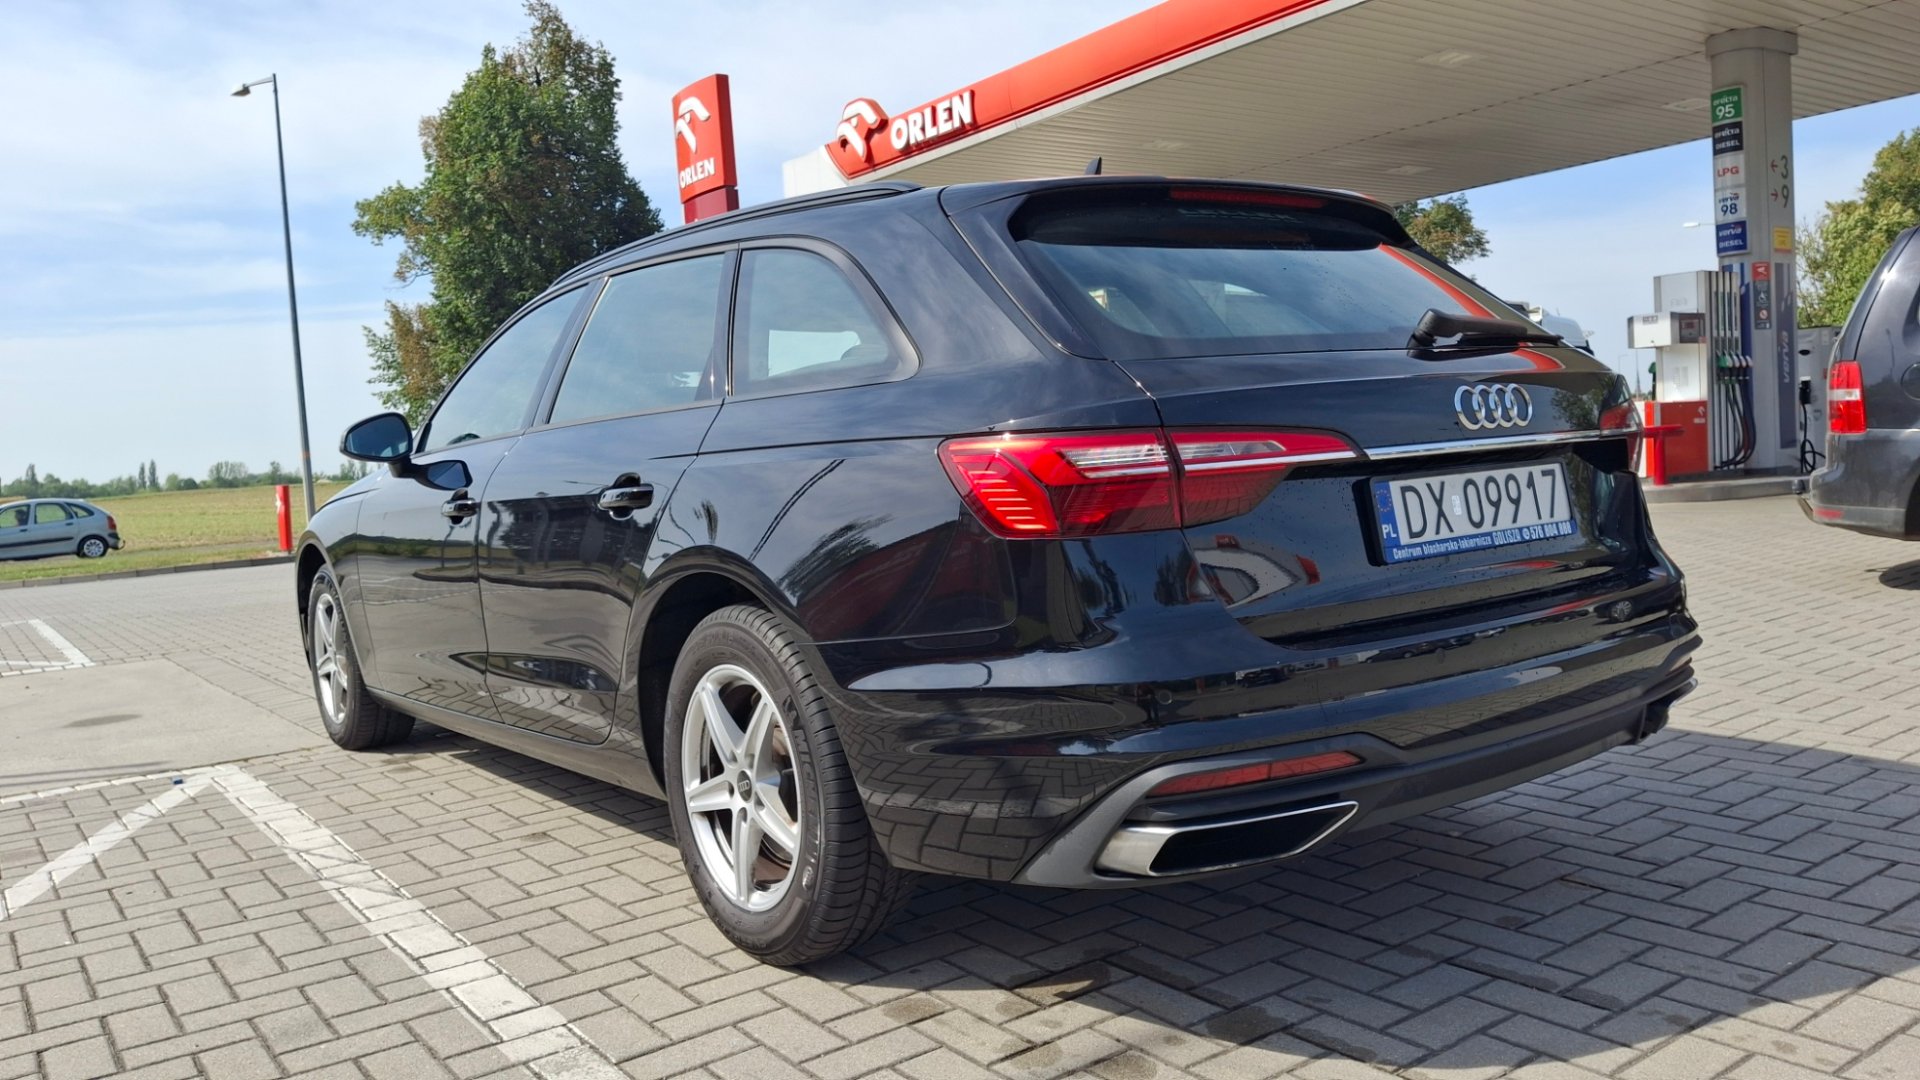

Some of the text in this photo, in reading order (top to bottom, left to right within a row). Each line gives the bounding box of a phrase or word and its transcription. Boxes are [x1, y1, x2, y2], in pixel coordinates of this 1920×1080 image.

[1715, 104, 1735, 119] 95
[890, 90, 973, 150] ORLEN
[1715, 140, 1740, 150] DIESEL
[679, 157, 715, 189] ORLEN
[1717, 166, 1739, 177] LPG
[1780, 155, 1789, 180] 3
[1718, 193, 1739, 204] verva
[1781, 185, 1790, 208] 9
[1720, 202, 1738, 217] 98
[1718, 226, 1742, 237] verva
[1718, 239, 1744, 249] DIESEL
[1781, 330, 1790, 383] verva
[1400, 469, 1556, 539] DX 09917
[1382, 524, 1397, 538] PL
[1392, 545, 1423, 560] Centrum
